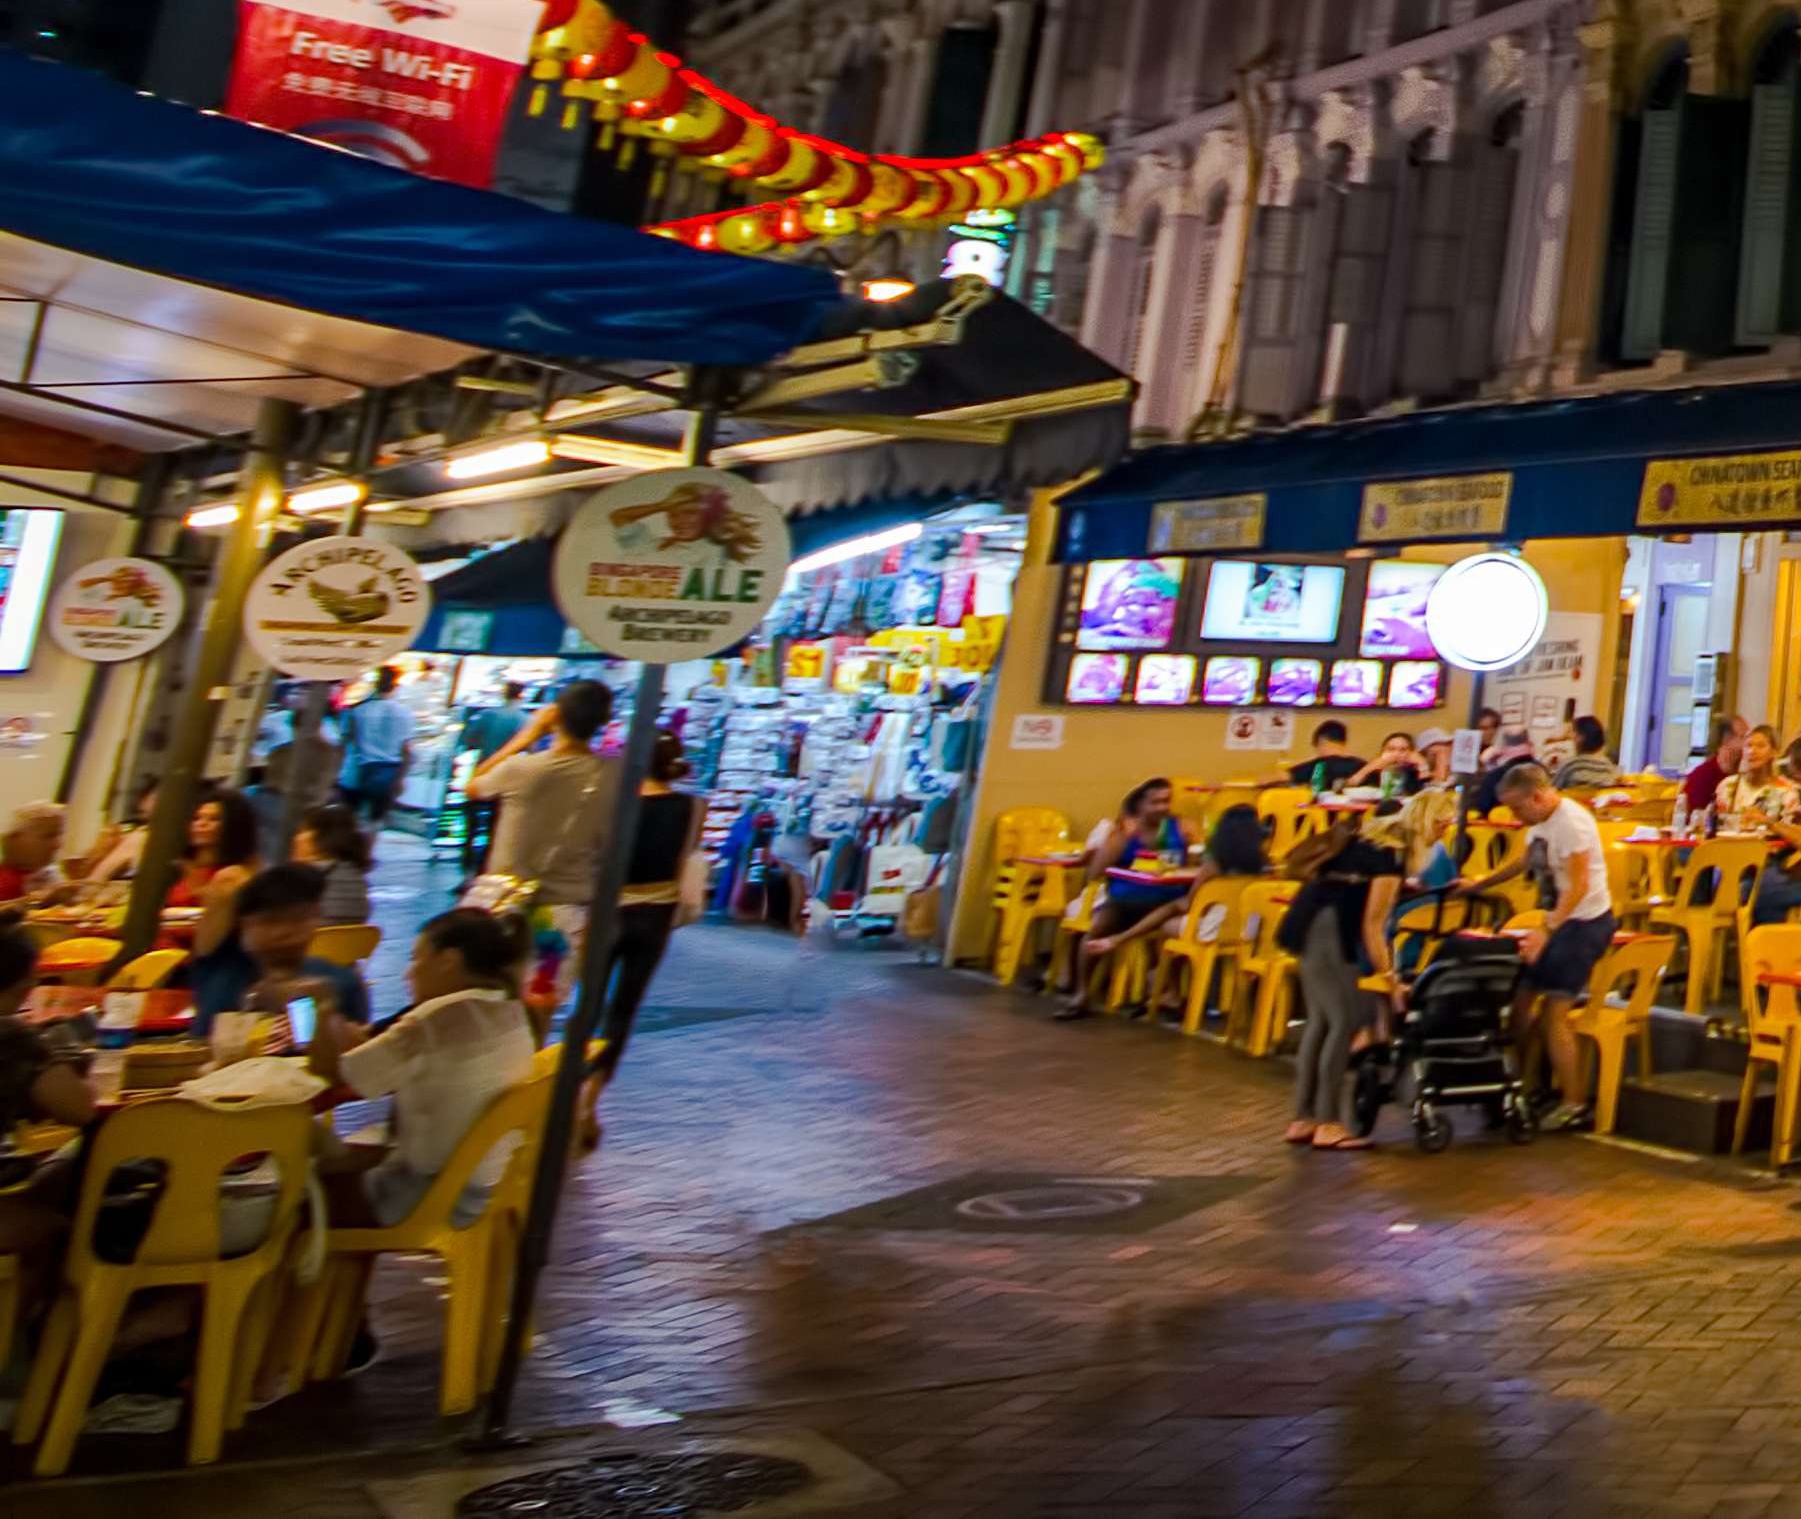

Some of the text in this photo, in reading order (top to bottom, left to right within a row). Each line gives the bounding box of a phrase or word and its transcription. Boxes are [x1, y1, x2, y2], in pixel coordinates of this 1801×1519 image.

[289, 31, 477, 91] Free Wi-Fi
[1690, 461, 1770, 486] CHINATOWN
[269, 546, 419, 604] ARCHIPELAGO
[679, 566, 765, 603] ALE
